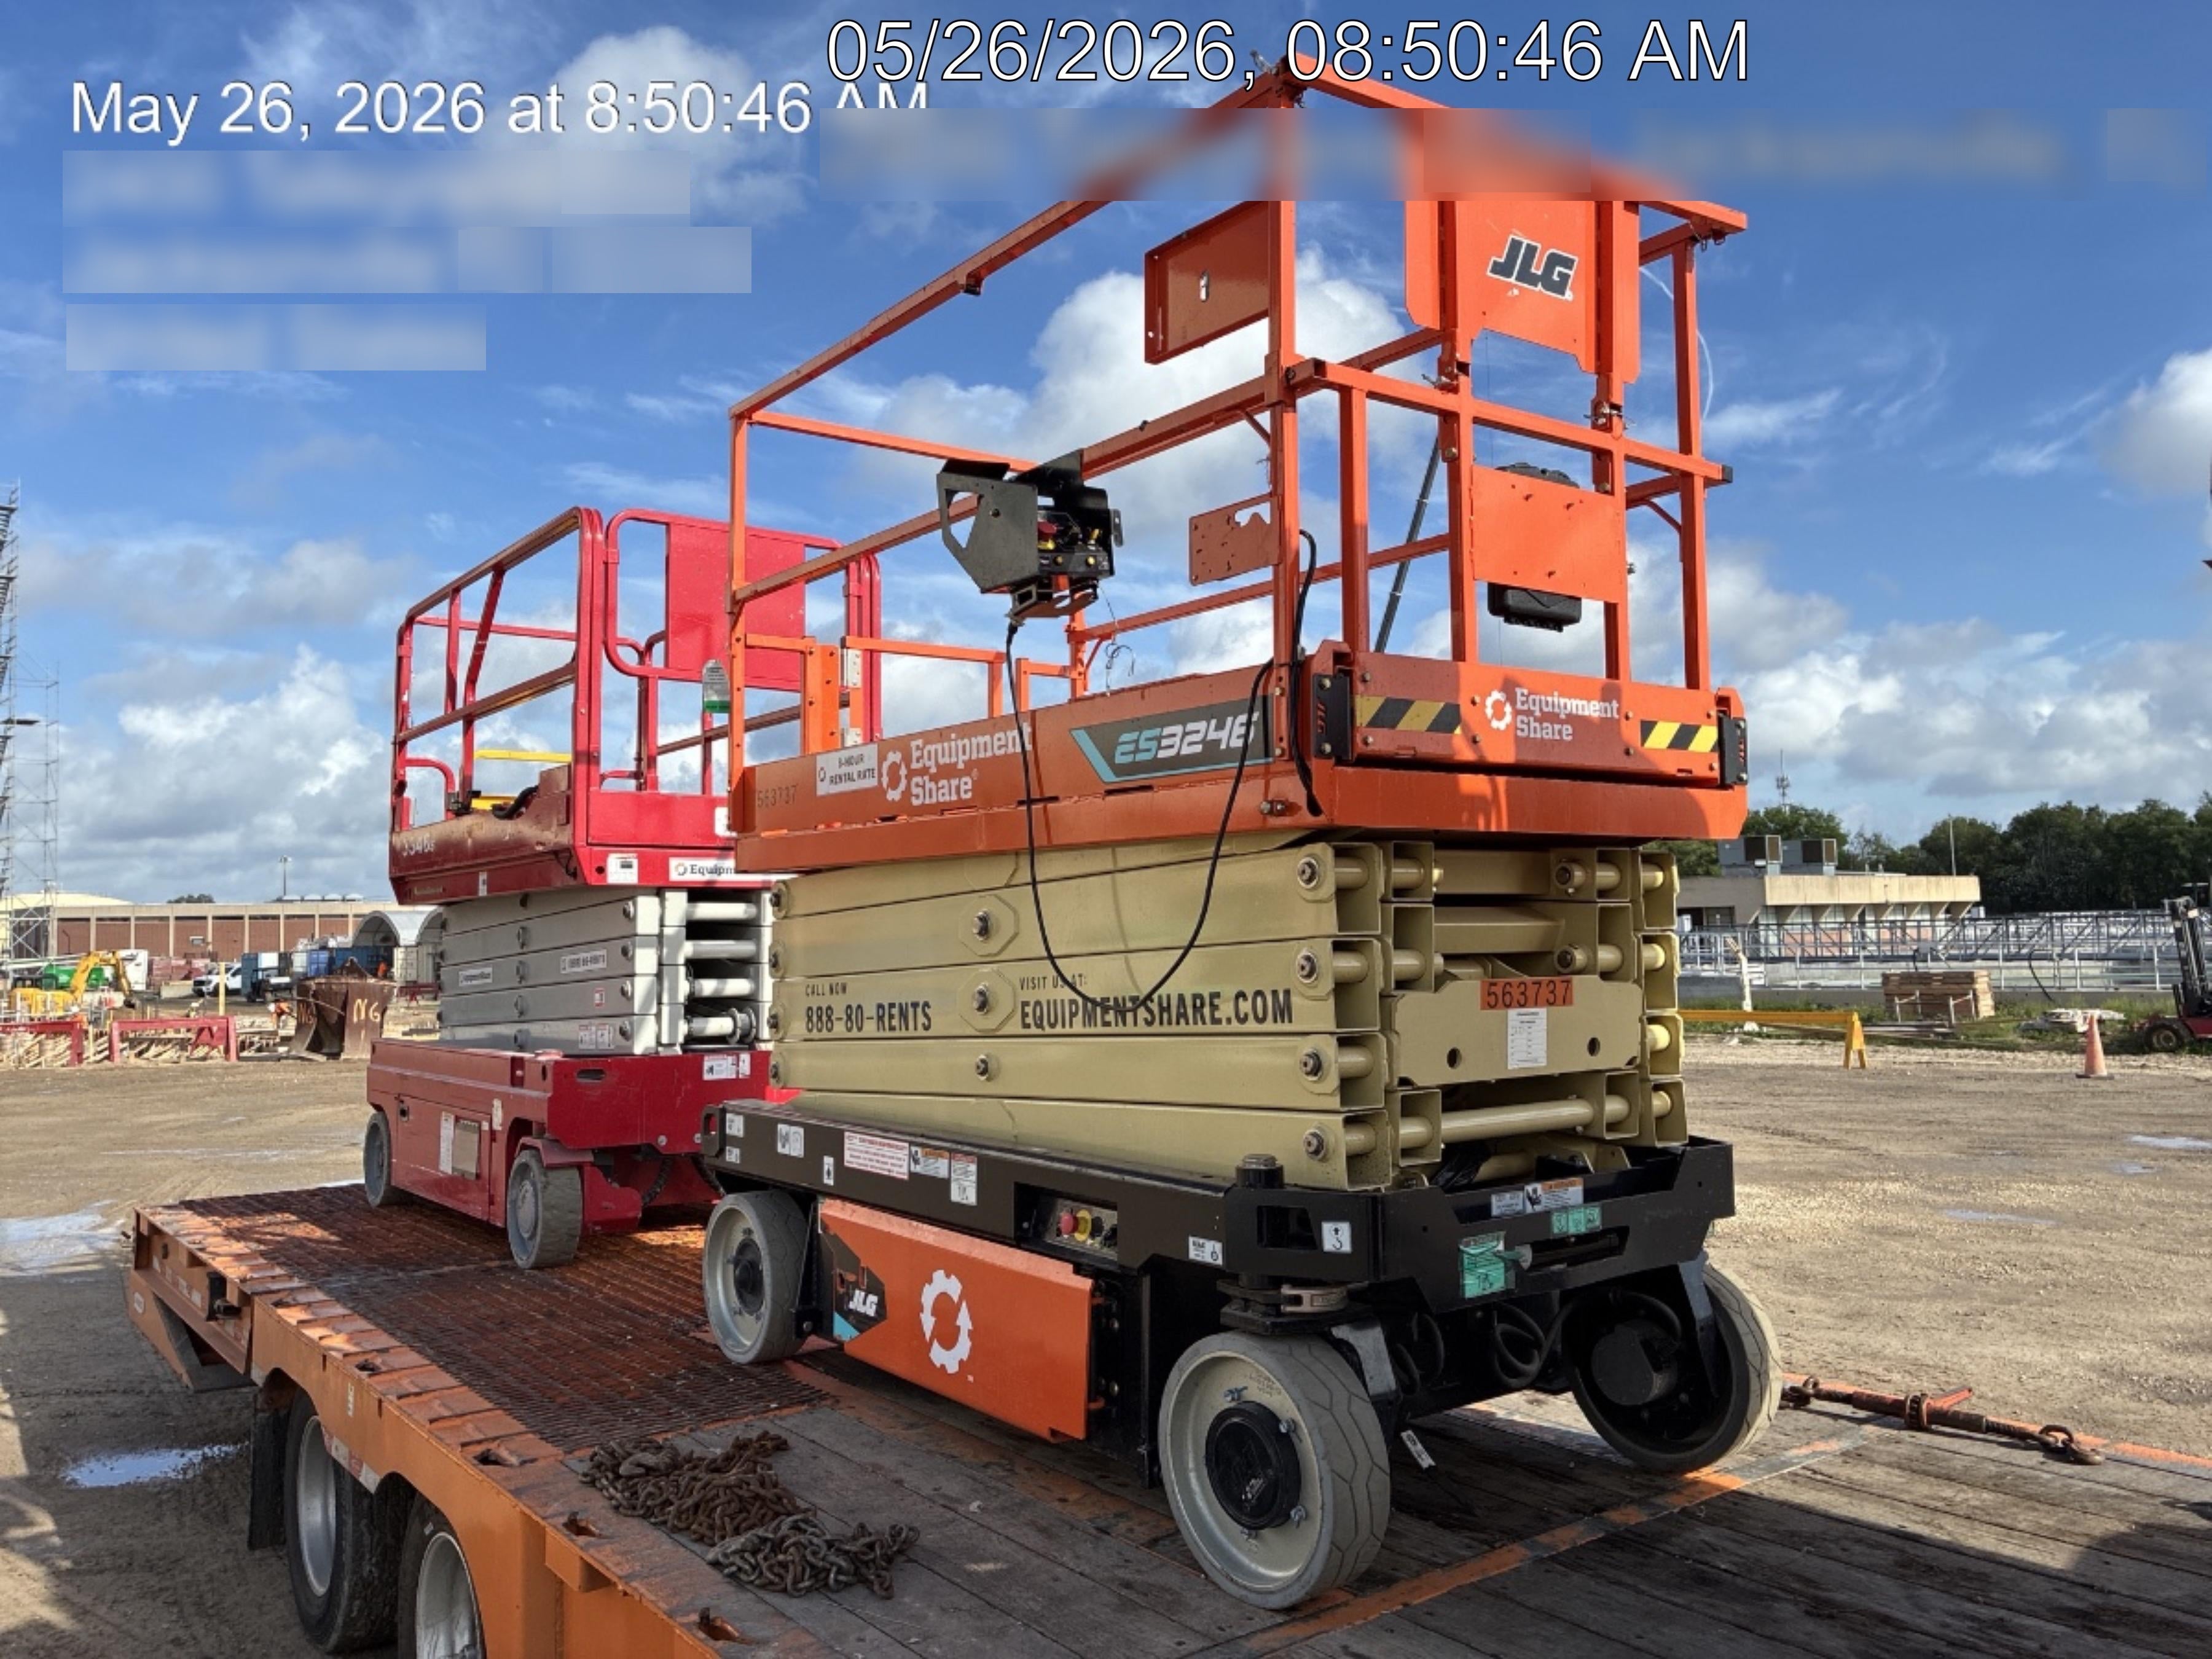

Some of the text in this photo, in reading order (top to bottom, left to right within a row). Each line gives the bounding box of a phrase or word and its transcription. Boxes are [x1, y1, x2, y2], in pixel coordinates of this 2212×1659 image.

[1486, 234, 1579, 302] JLG
[1515, 687, 1619, 719] Equipment
[1516, 715, 1574, 742] Share
[910, 722, 1032, 773] Equipment
[910, 775, 972, 806] Share
[805, 982, 847, 997] CALL NOW
[1019, 976, 1047, 990] VISIT
[1487, 981, 1572, 1008] 563737
[806, 1001, 931, 1033] 888-80-RENTS
[1020, 988, 1293, 1032] EQUIPMENTSHARE.COM
[849, 1288, 879, 1317] JLG
